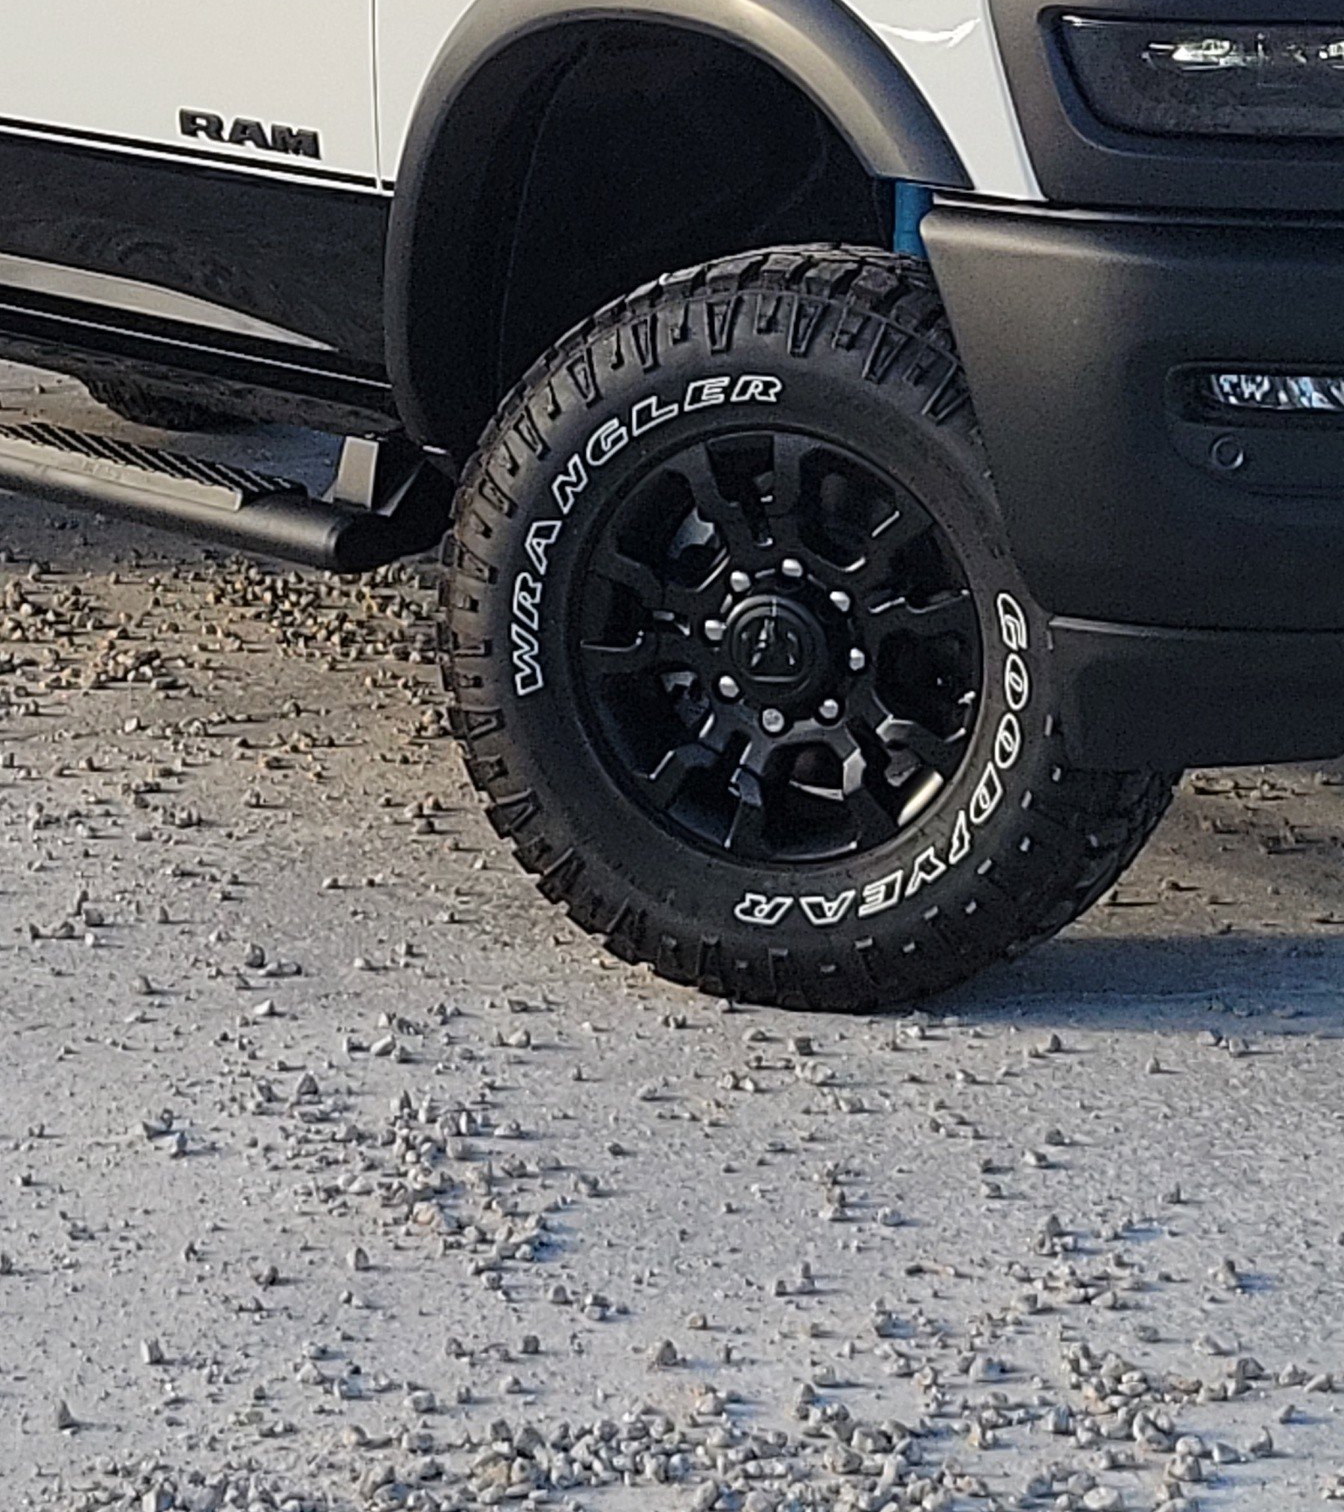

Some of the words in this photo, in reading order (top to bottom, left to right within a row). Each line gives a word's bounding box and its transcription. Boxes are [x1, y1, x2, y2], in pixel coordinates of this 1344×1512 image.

[179, 107, 322, 160] RAM
[513, 375, 782, 696] WRANGLER
[734, 593, 1030, 925] GOODYEAR
